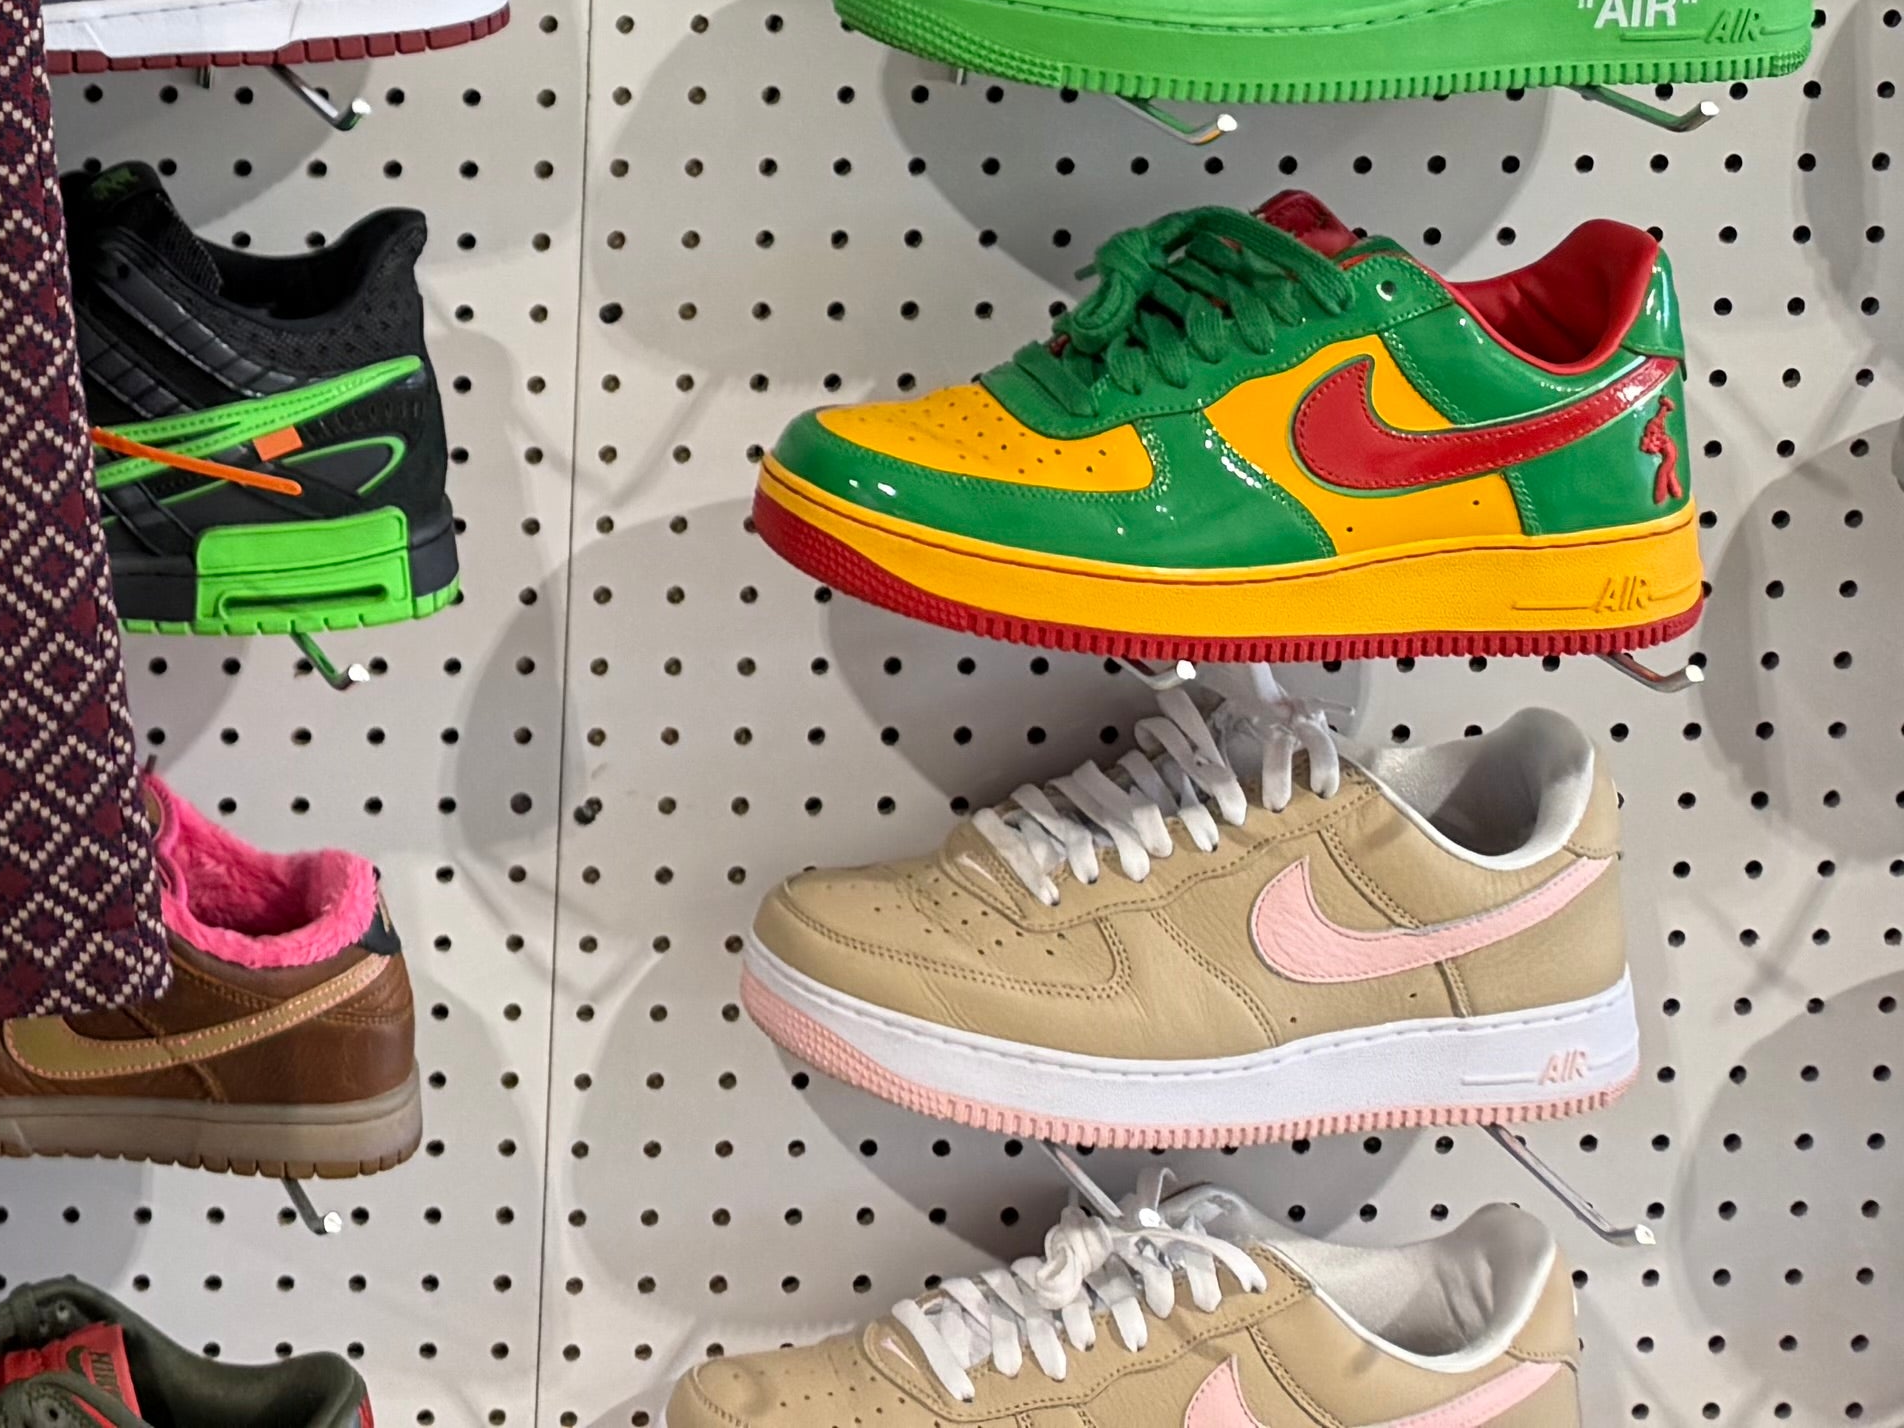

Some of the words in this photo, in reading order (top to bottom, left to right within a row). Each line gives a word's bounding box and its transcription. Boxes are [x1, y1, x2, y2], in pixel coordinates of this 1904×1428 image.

[1704, 8, 1761, 45] AIR
[1594, 575, 1652, 613] AIR
[1537, 1047, 1589, 1086] AIR
